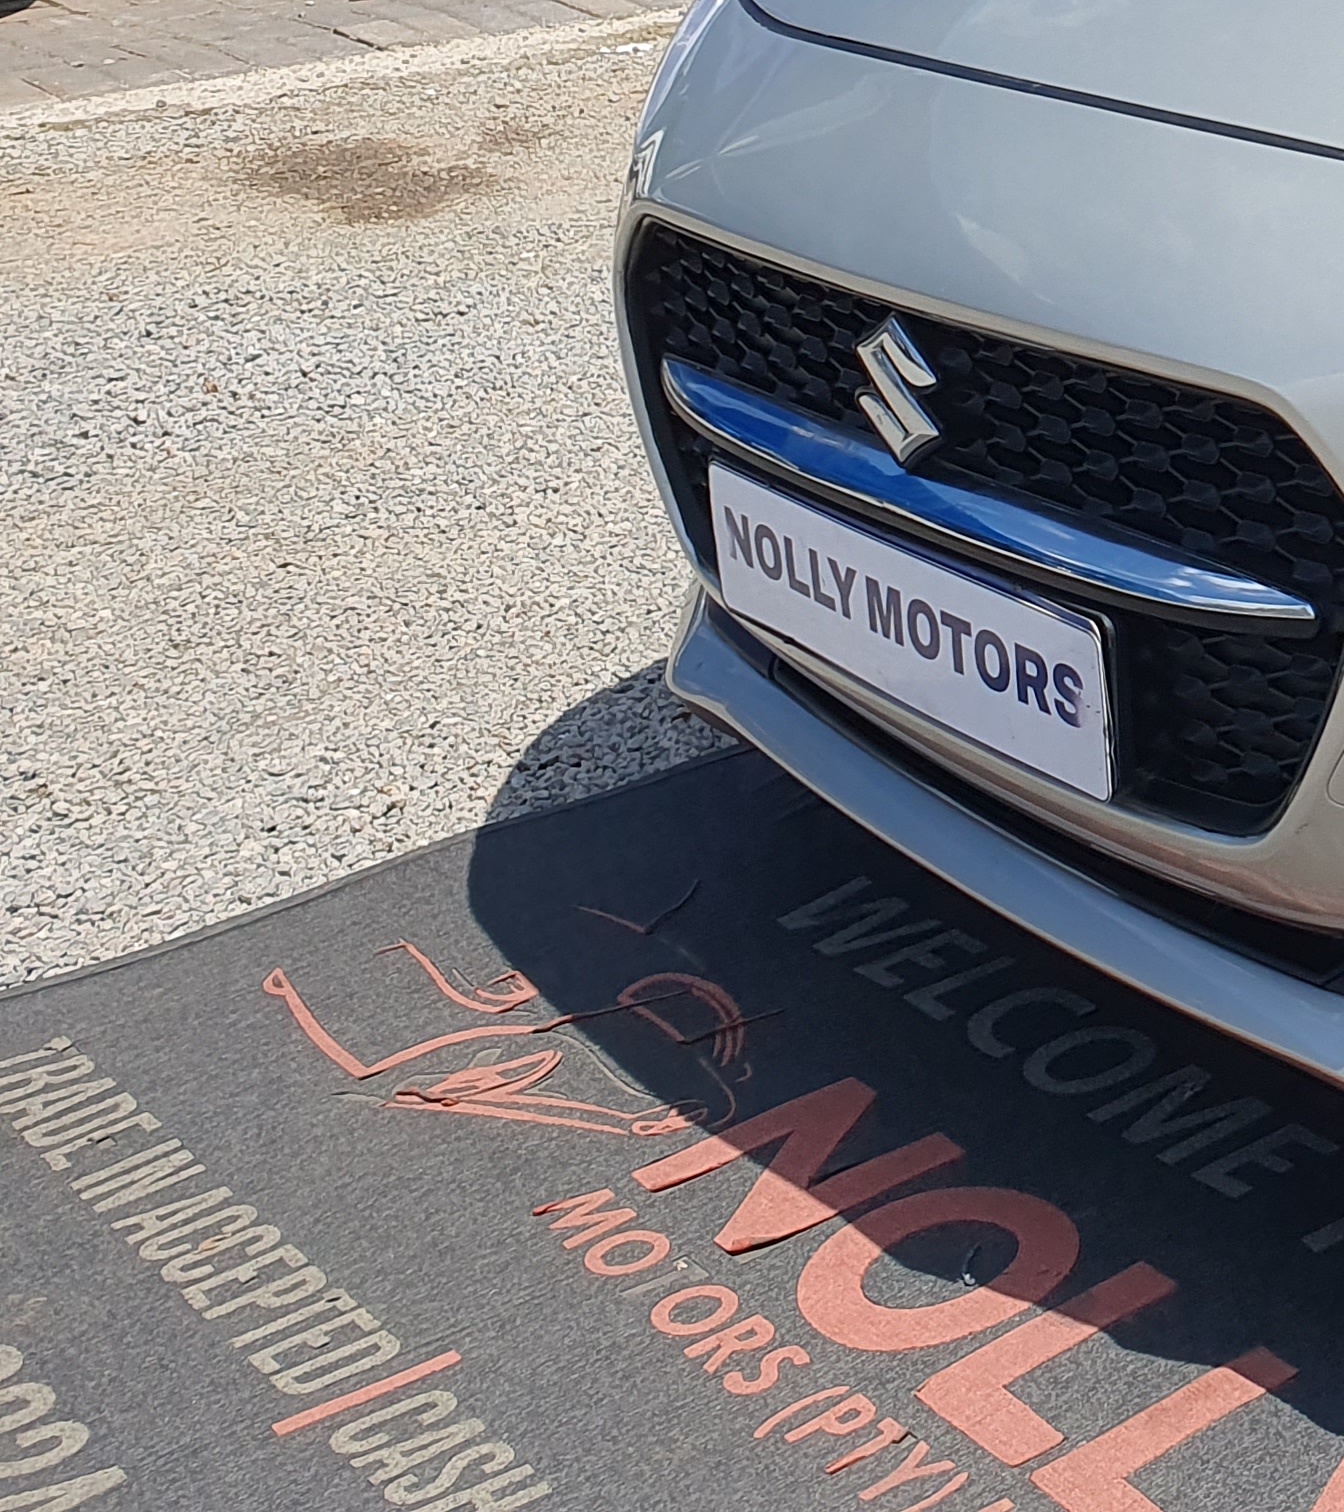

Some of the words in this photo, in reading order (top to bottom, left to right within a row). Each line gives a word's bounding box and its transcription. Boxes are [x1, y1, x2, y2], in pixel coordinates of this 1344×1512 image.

[723, 505, 857, 620] NOLLY
[865, 574, 1085, 729] MOTORS
[0, 1035, 163, 1172] TRADE
[775, 875, 1340, 1199] WELCOME
[70, 1138, 207, 1213] IN
[110, 1186, 401, 1395] ACCEPTED
[328, 1389, 553, 1512] CASH
